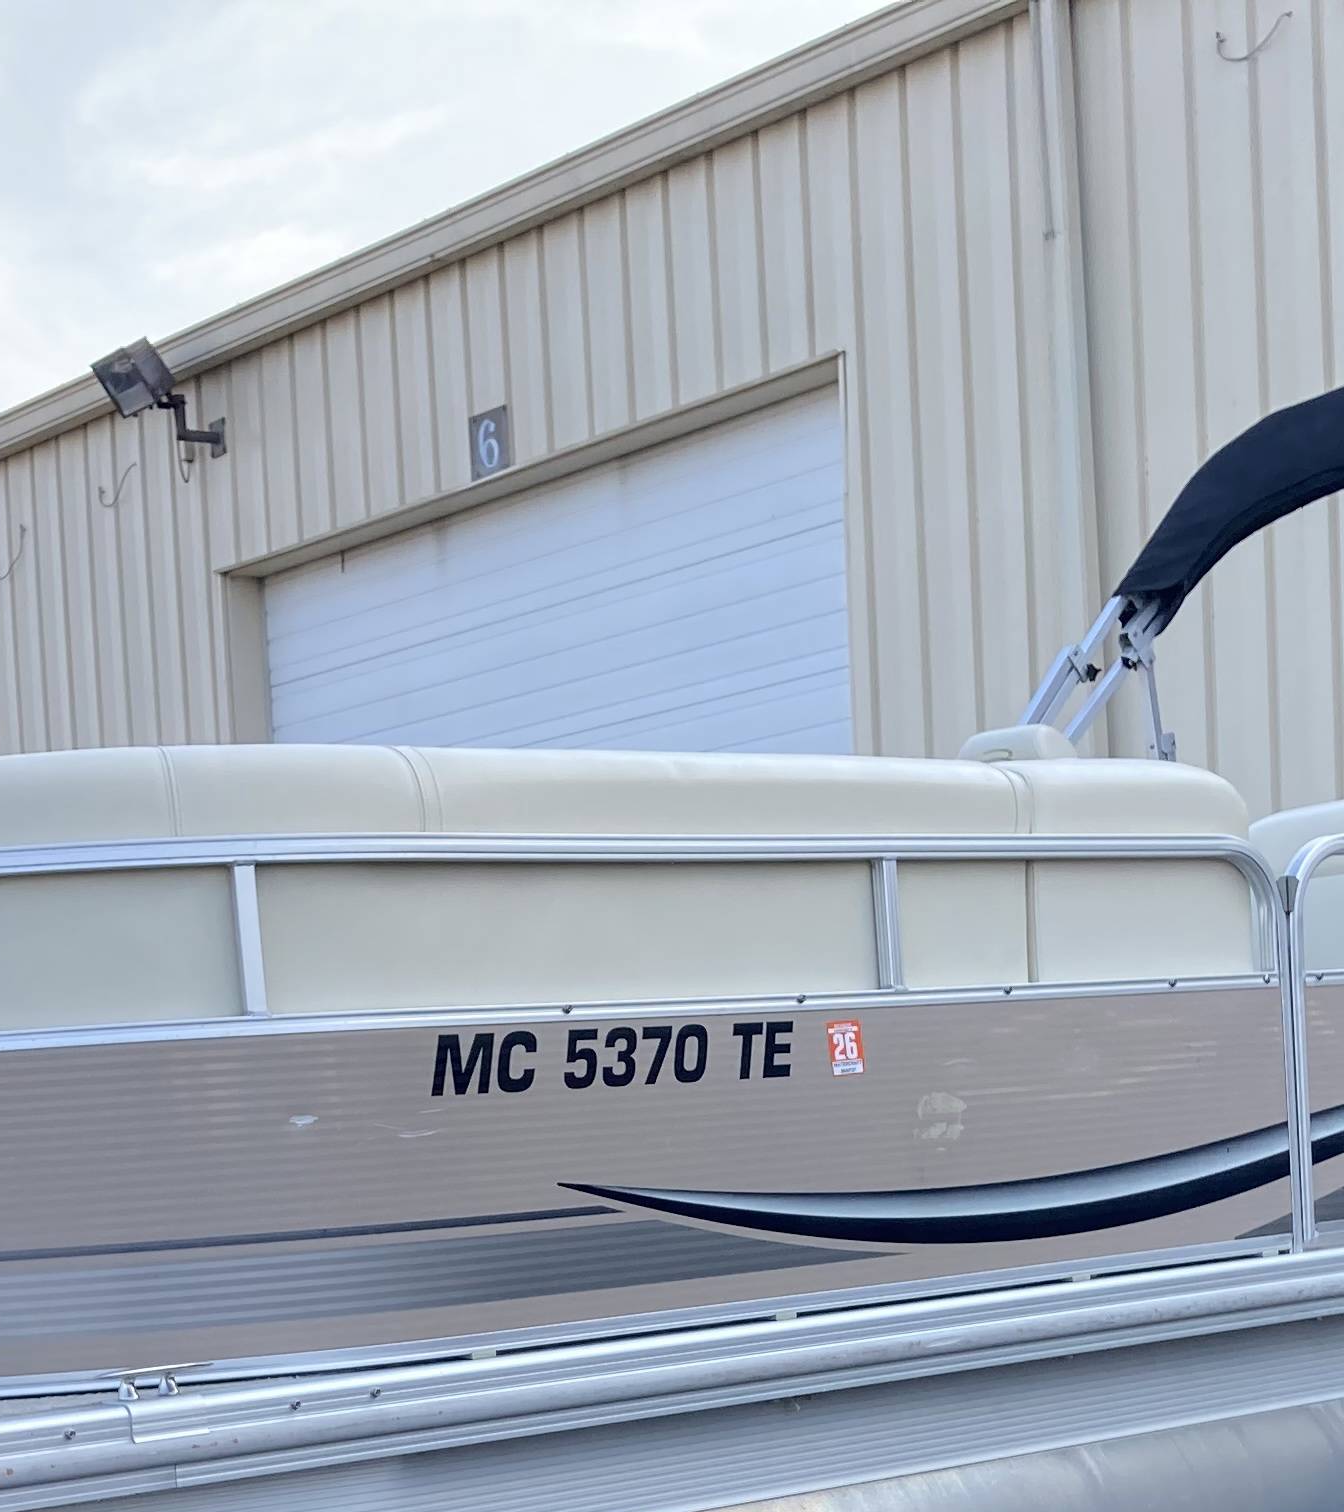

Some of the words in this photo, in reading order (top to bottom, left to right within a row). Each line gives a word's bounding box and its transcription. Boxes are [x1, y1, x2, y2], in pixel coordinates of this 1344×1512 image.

[478, 419, 499, 468] 6
[431, 1031, 538, 1097] MC
[563, 1023, 708, 1090] 5370
[733, 1020, 794, 1080] TE
[833, 1031, 858, 1060] 26
